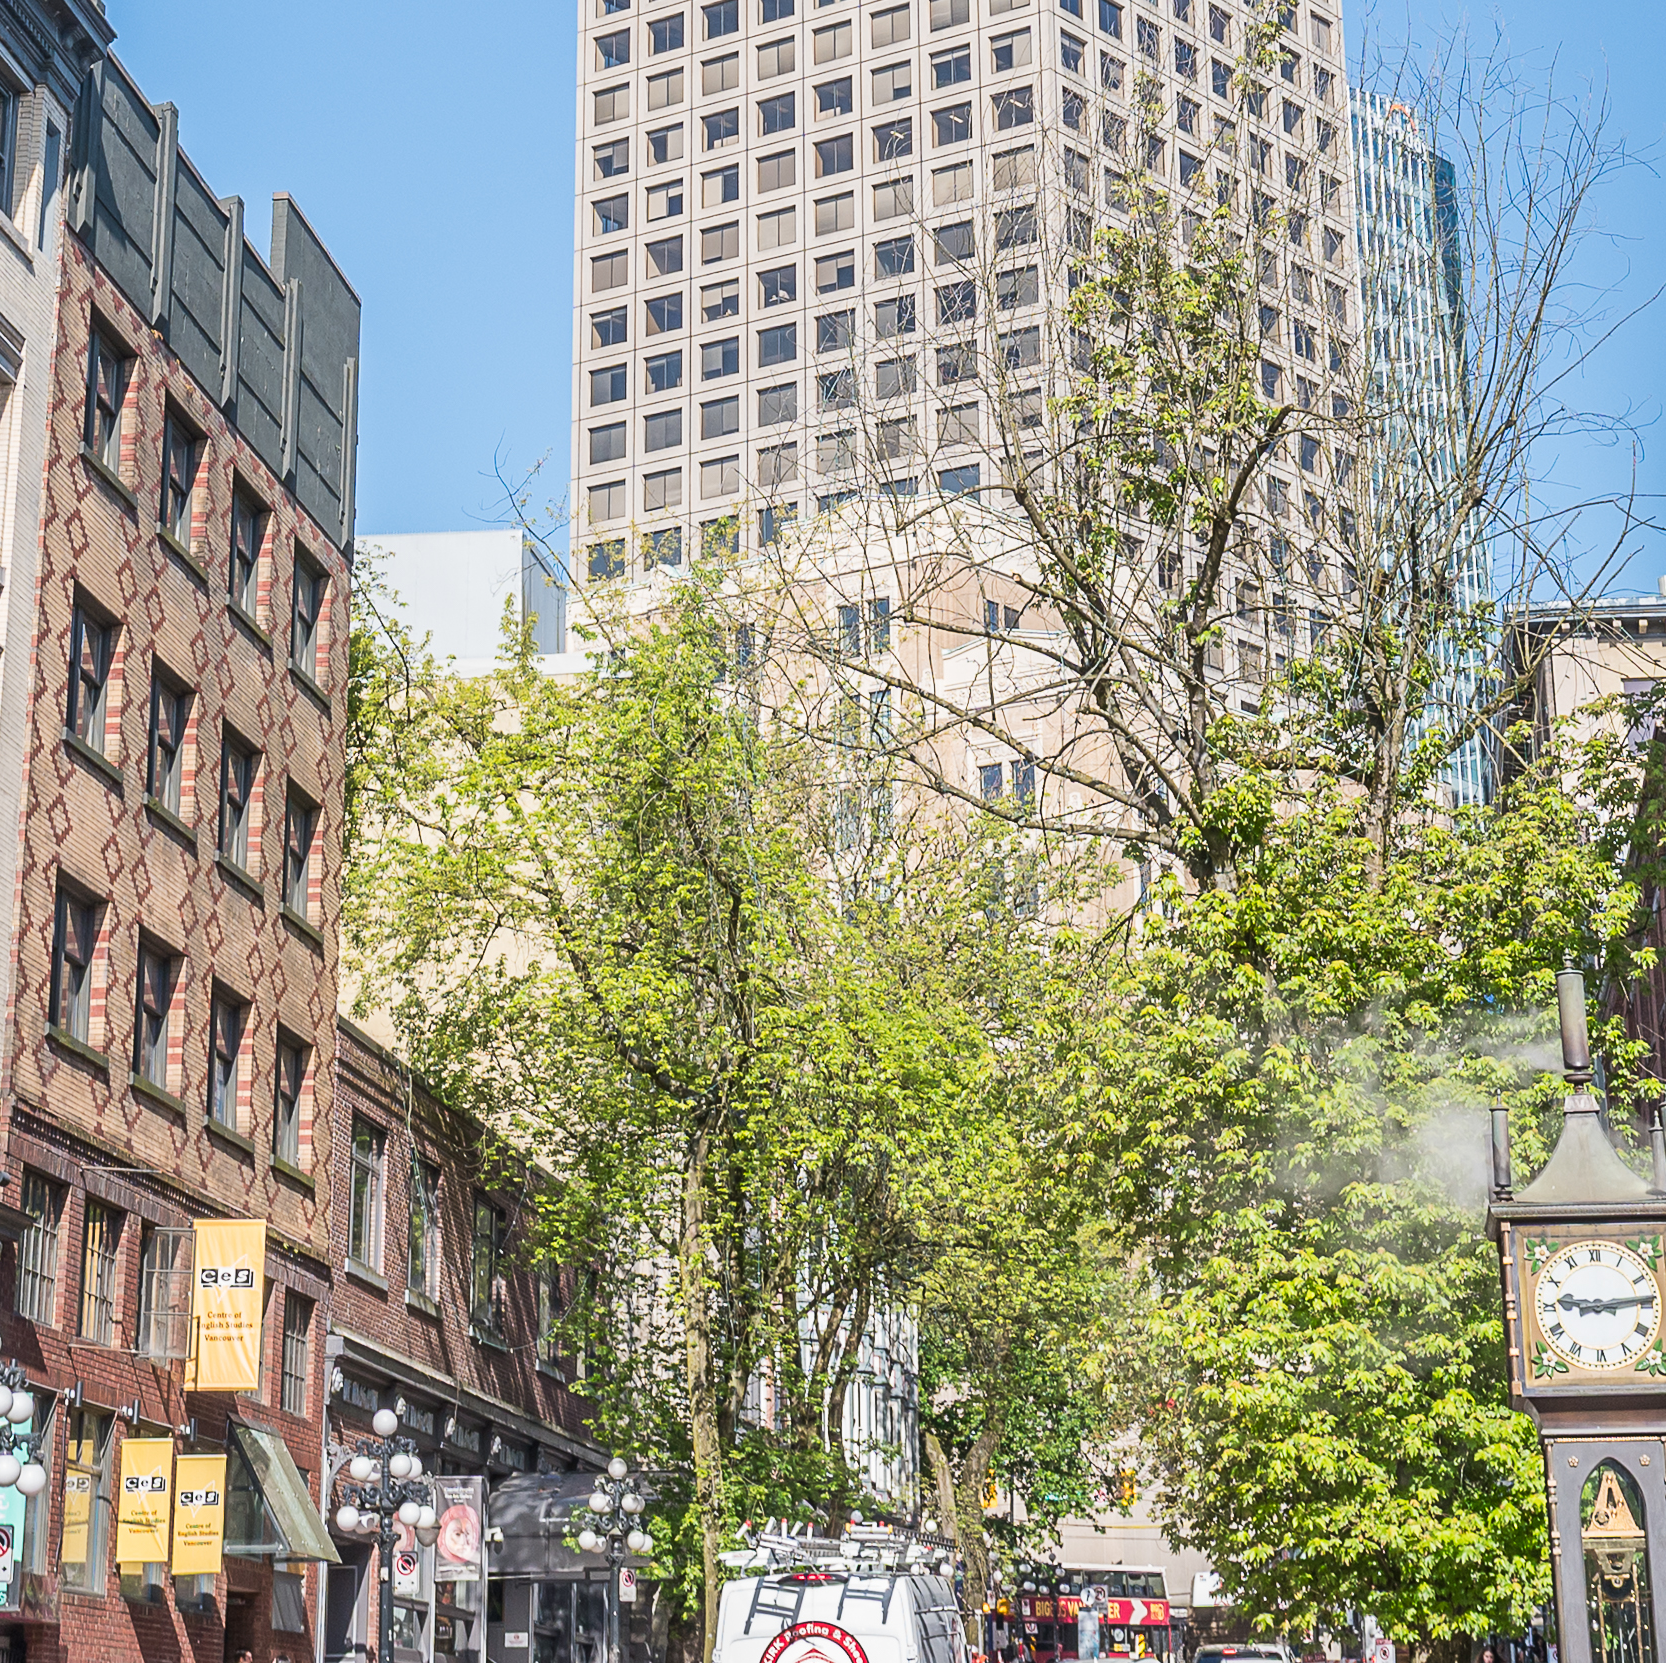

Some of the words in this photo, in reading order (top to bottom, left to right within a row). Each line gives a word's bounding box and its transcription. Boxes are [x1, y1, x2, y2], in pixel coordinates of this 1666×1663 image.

[207, 1311, 232, 1319] Centre
[234, 1311, 243, 1319] of
[225, 1321, 253, 1329] Studies
[204, 1334, 244, 1342] Vancouver
[785, 1622, 830, 1643] Roofing
[833, 1629, 842, 1641] &
[843, 1635, 865, 1663] Shee
